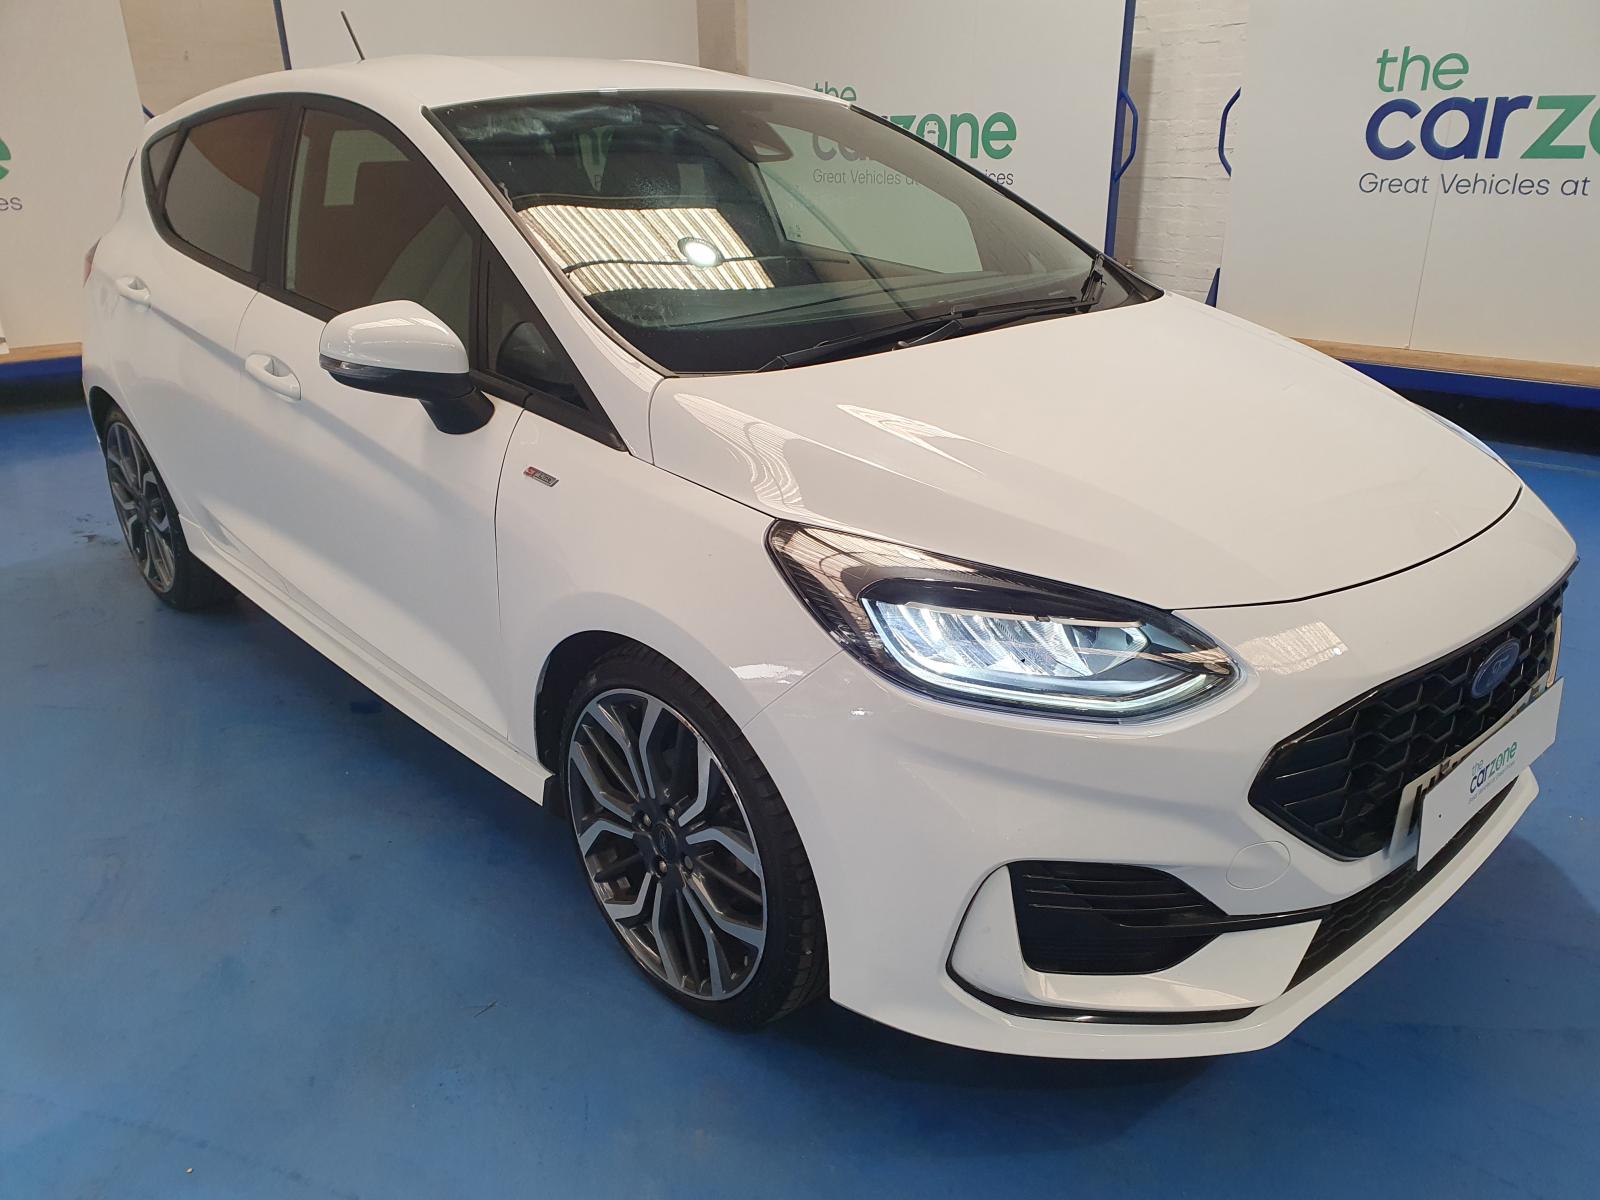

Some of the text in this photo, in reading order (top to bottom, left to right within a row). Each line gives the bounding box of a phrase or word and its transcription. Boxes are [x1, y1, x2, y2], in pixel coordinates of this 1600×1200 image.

[1376, 46, 1469, 92] the
[1366, 95, 1600, 161] carz
[812, 168, 847, 184] Great
[850, 169, 902, 186] Vehicles
[1359, 172, 1591, 196] Great Vehicles at
[1469, 741, 1518, 794] carzone
